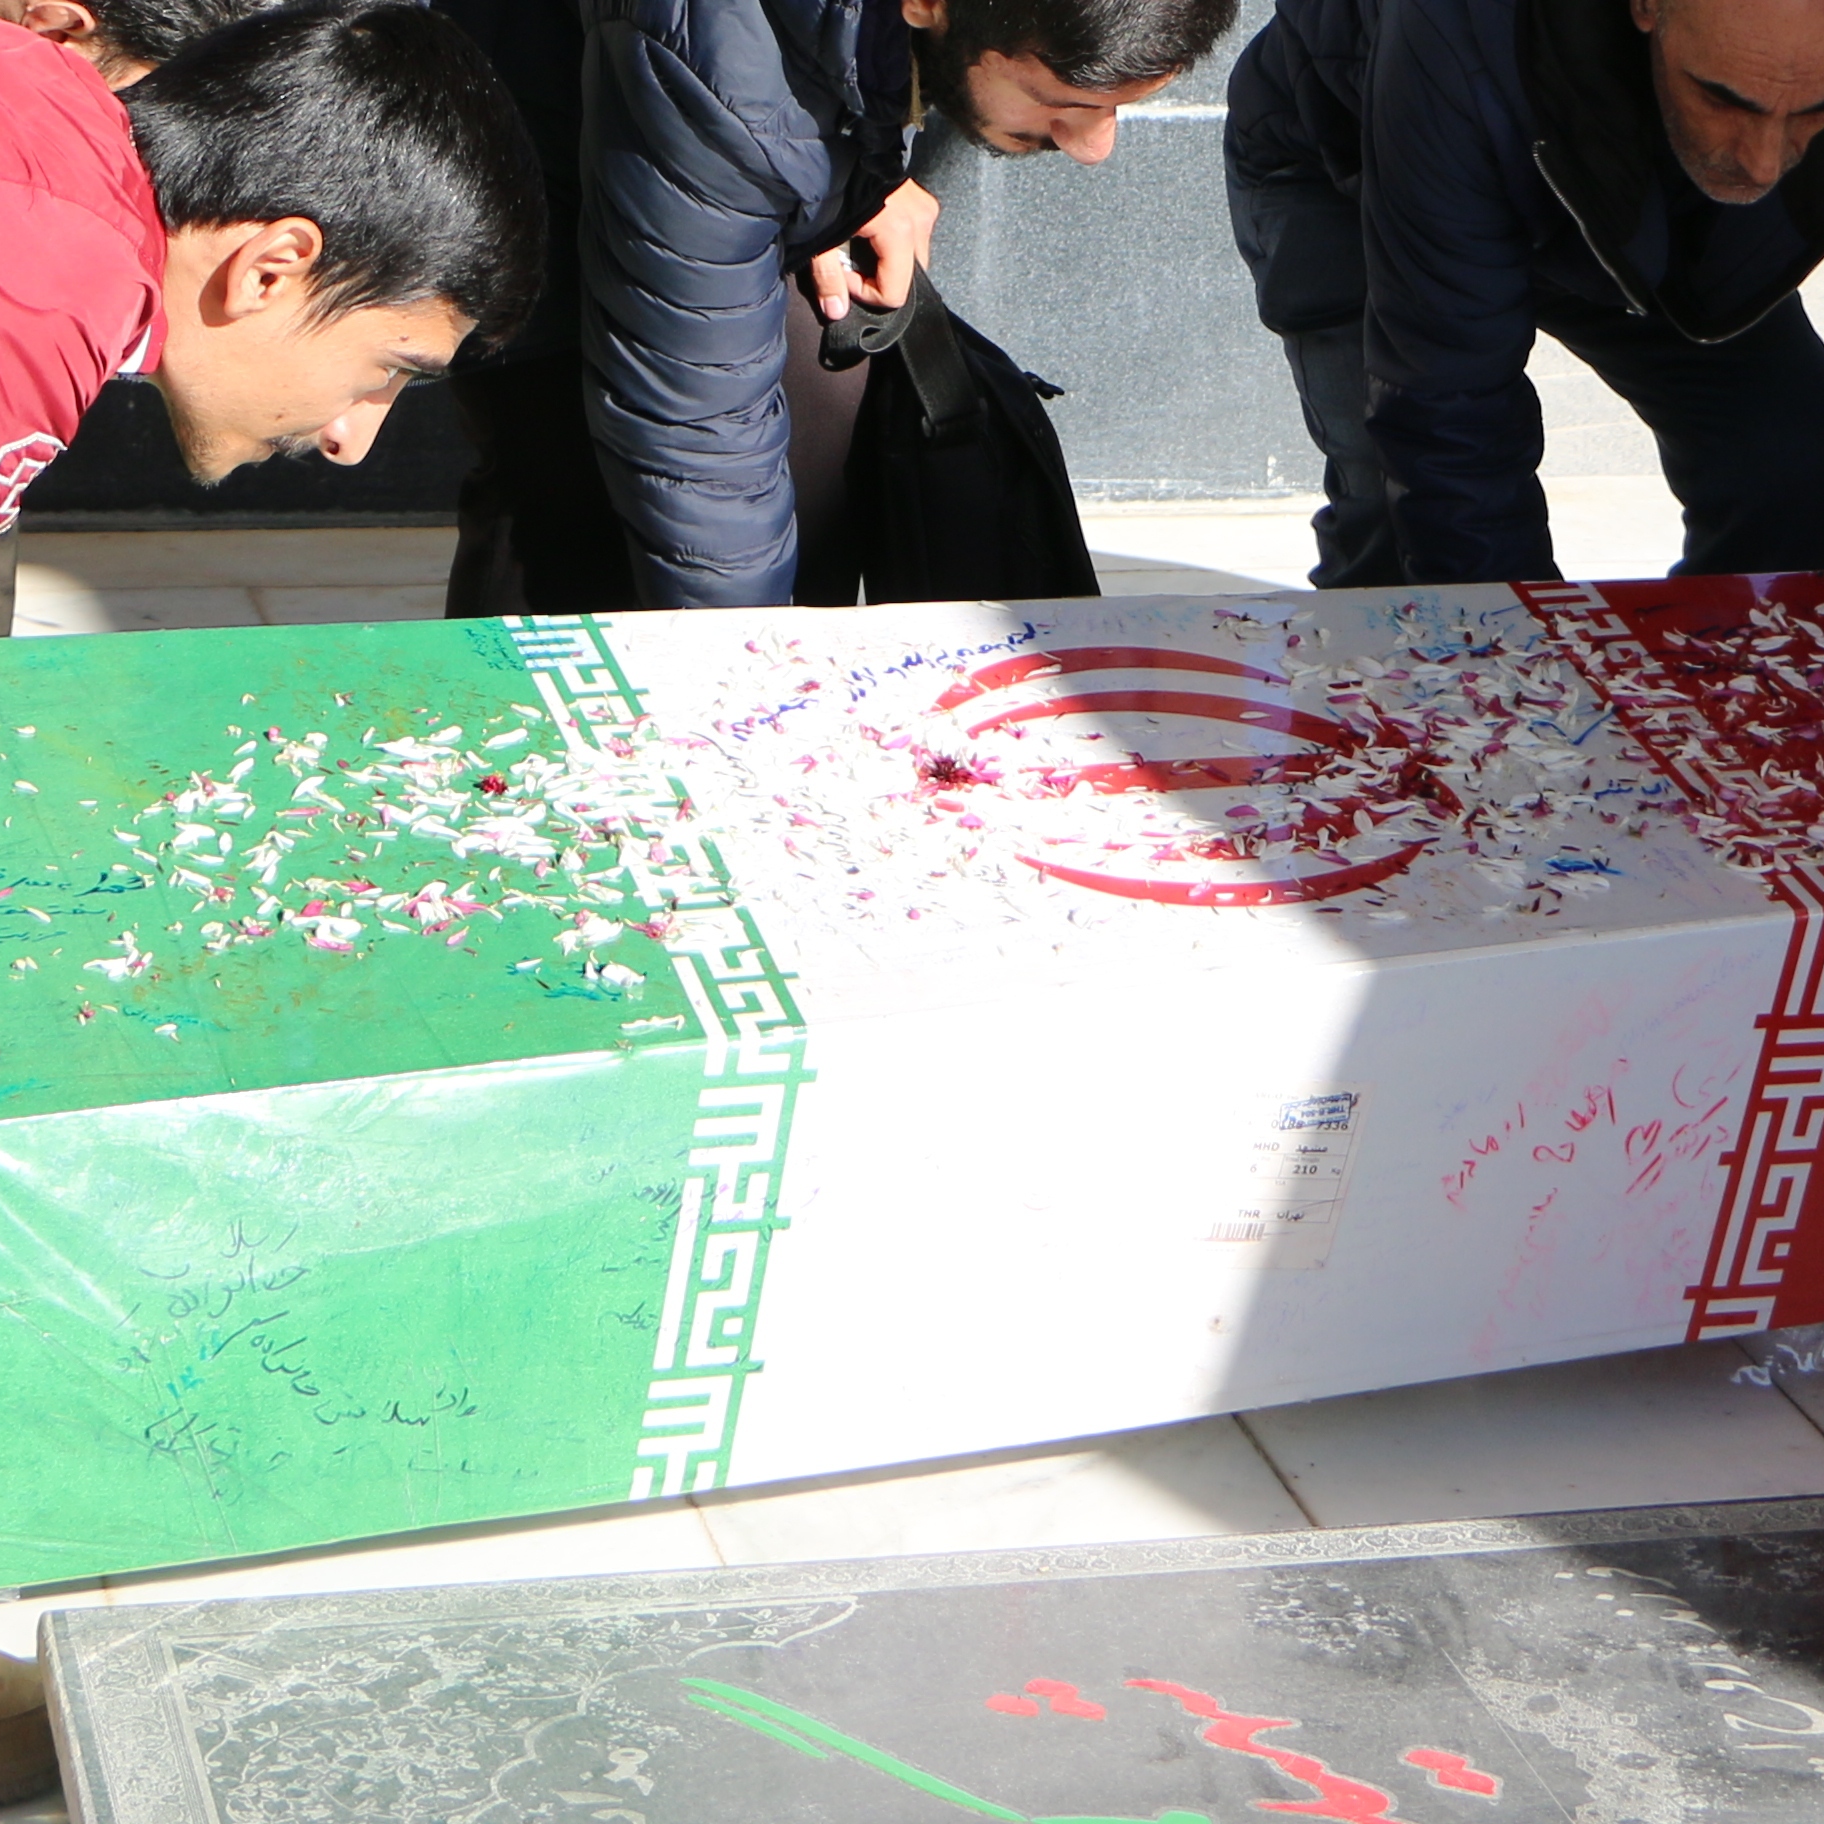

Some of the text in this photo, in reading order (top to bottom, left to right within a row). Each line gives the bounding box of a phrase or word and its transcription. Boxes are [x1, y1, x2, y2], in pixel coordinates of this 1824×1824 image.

[1252, 1142, 1280, 1151] MHD
[1292, 1165, 1318, 1175] 210
[1237, 1209, 1261, 1219] THR
